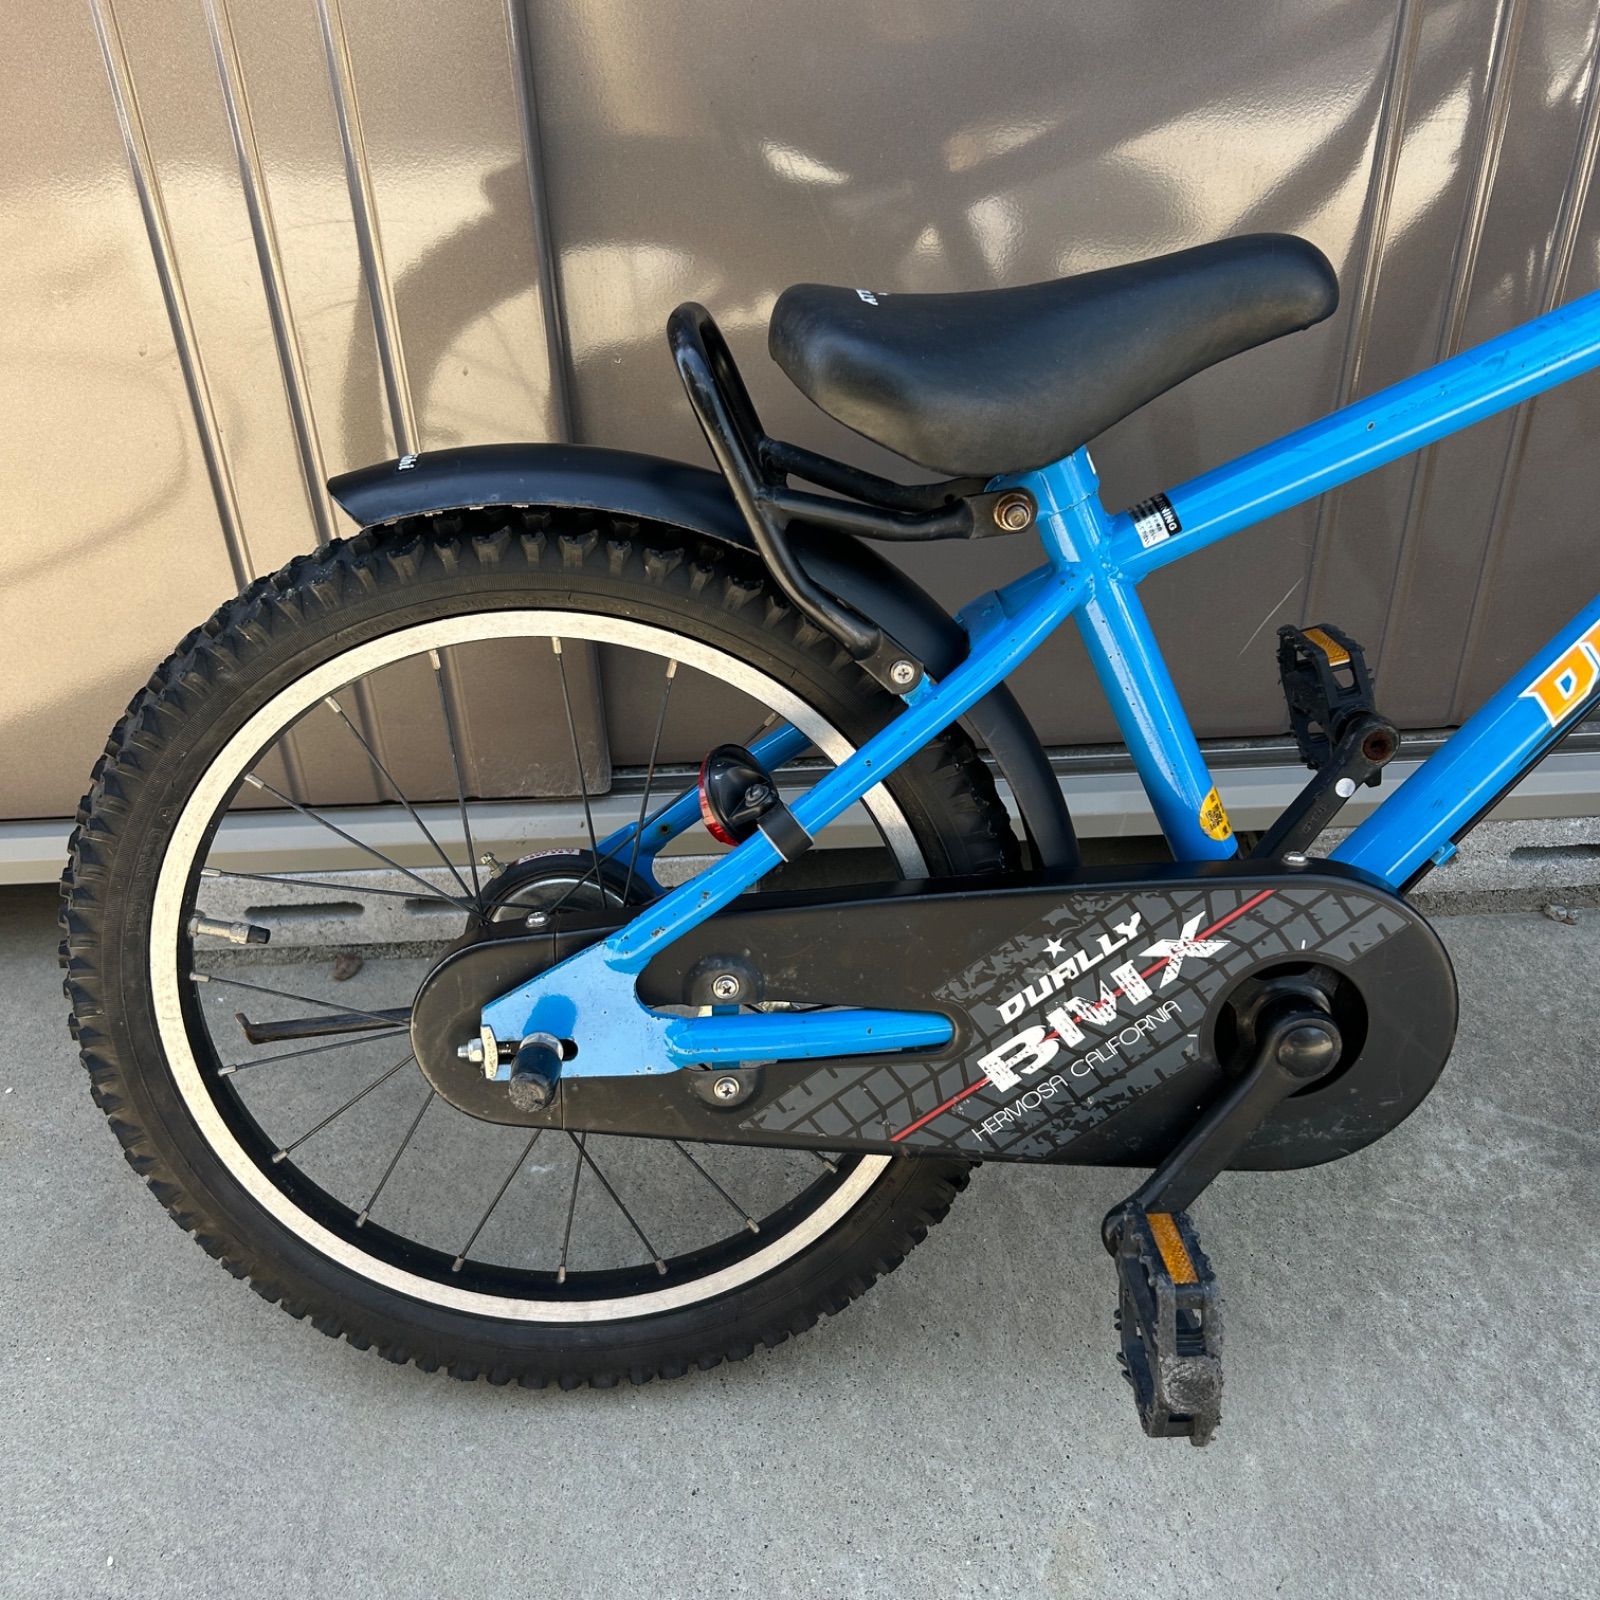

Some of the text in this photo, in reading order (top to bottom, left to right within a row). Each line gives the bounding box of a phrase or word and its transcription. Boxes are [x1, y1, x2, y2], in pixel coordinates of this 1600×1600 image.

[977, 911, 1231, 1093] BMX
[996, 911, 1142, 1025] DUALLY
[971, 1000, 1182, 1141] HERMOSA CALIFORNIA
